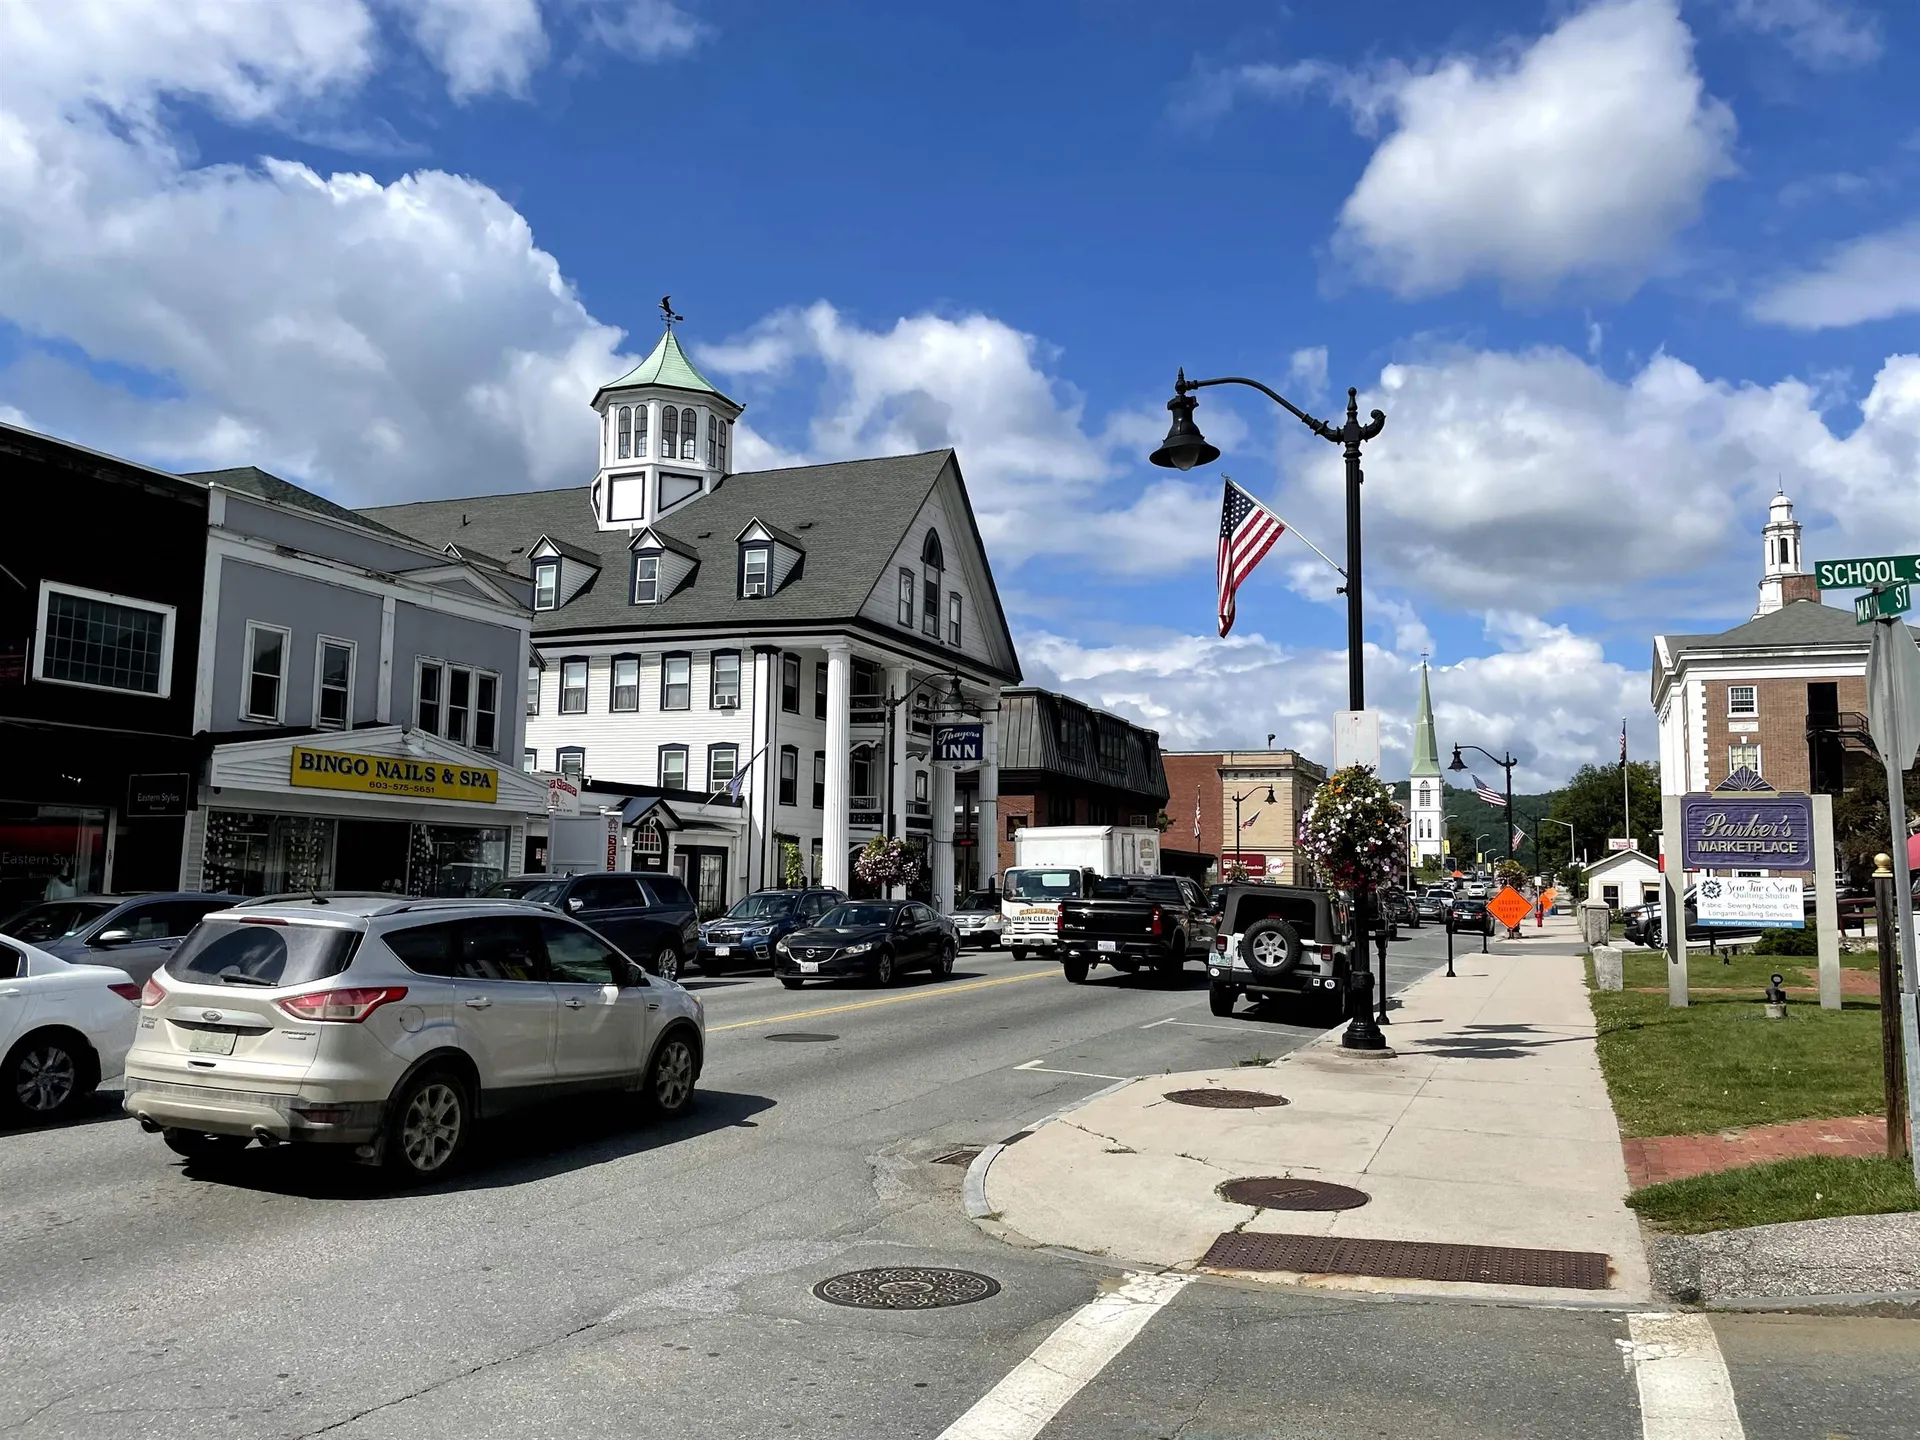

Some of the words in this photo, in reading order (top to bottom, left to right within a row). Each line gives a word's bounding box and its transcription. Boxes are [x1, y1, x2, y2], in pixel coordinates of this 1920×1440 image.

[1821, 561, 1904, 586] SCHOOL
[1856, 595, 1880, 621] MAIN
[1895, 585, 1907, 608] ST
[936, 728, 980, 745] Thayers
[942, 744, 976, 758] INN
[299, 752, 369, 776] BINGO
[376, 761, 436, 782] NAILS
[441, 769, 455, 785] &
[459, 771, 492, 788] SPA
[369, 781, 435, 793] 603-575-5651
[137, 793, 160, 802] Eastern
[161, 792, 180, 803] Styles
[1701, 812, 1793, 838] Parker's
[1697, 841, 1798, 853] MARKETPLACE
[2, 852, 49, 865] Eastern
[52, 853, 81, 866] Style
[1724, 881, 1745, 895] Sew
[1733, 892, 1764, 900] Quilting
